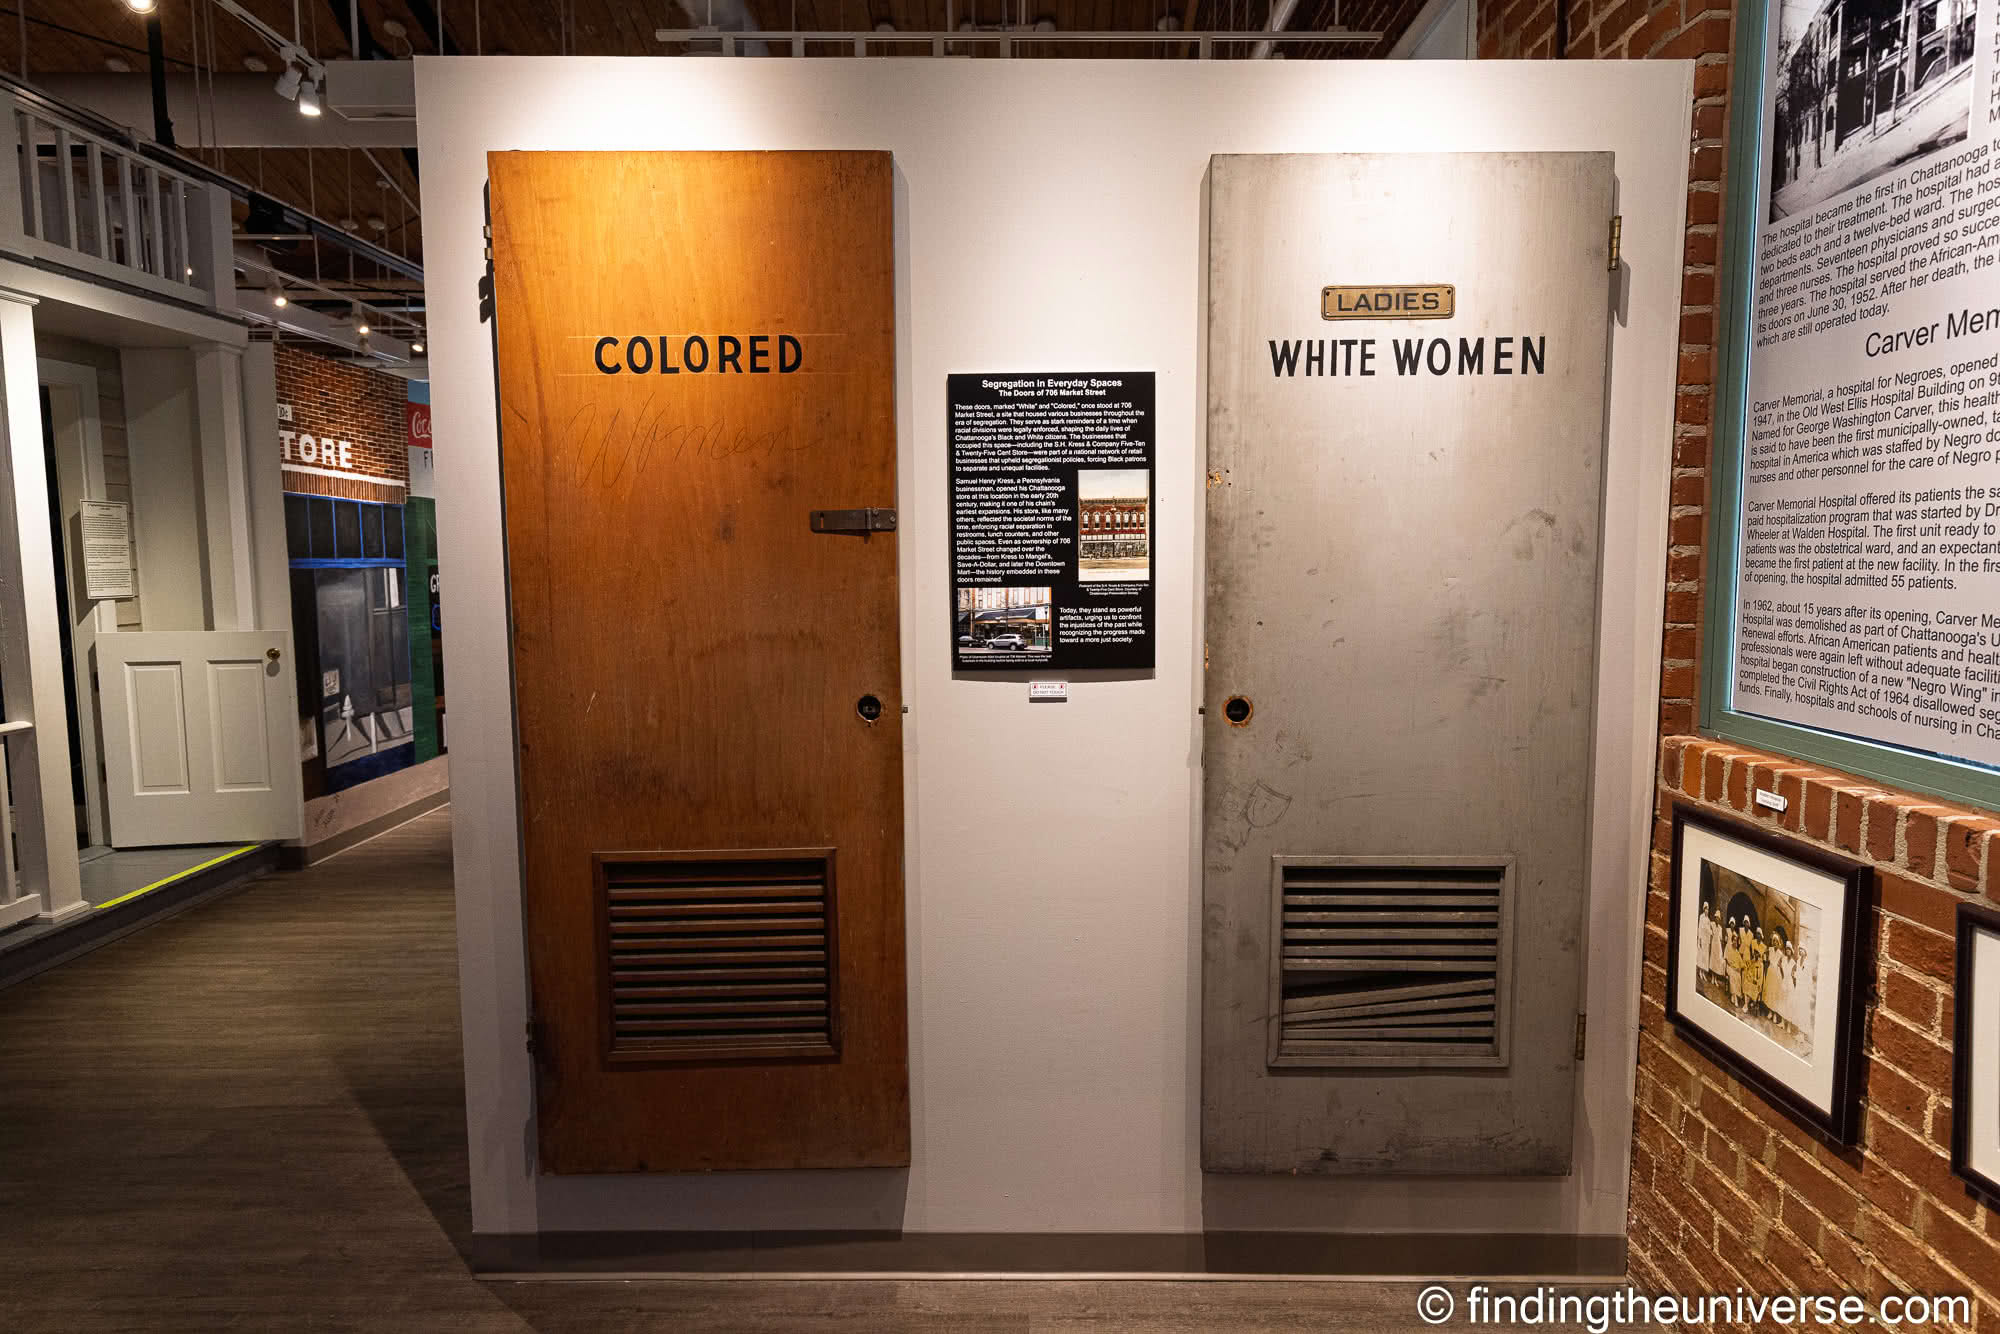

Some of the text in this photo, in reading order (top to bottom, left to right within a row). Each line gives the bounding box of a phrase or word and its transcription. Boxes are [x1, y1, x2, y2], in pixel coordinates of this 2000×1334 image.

[1760, 234, 1802, 261] dedicated
[1803, 232, 1812, 245] to
[1814, 222, 1836, 240] their
[1837, 201, 1888, 231] treatment.
[1891, 193, 1913, 210] The
[1915, 169, 1962, 200] hospital
[1965, 158, 1990, 181] had
[1761, 232, 1778, 248] The
[1779, 214, 1813, 239] hospital
[1815, 201, 1853, 224] became
[1855, 193, 1872, 208] the
[1874, 180, 1894, 200] first
[1897, 177, 1907, 191] in
[1910, 144, 1988, 185] Chattanooga
[1337, 292, 1439, 312] LADIES
[1757, 254, 1994, 334] its doors on June 30, 1952. After her death, the
[1756, 302, 1890, 349] which are still operated today.
[1865, 322, 1940, 357] Carver
[593, 335, 803, 374] COLORED
[1268, 336, 1546, 377] WHITE WOMEN
[981, 379, 1035, 389] Segregation
[1047, 378, 1088, 389] Everyday
[1089, 378, 1122, 388] Spaces
[1036, 388, 1044, 396] of
[1045, 388, 1058, 396] 706
[1752, 351, 2000, 413] Carver Memorial, a hospital for Negroes, opened
[1751, 425, 1781, 441] Named
[1782, 424, 1795, 437] for
[1796, 420, 1830, 435] George
[1832, 410, 1891, 429] Washington
[1893, 403, 1934, 420] Carver,
[1938, 397, 1960, 413] this
[1747, 500, 1775, 512] Carver
[1776, 496, 1816, 511] Memorial
[1818, 493, 1857, 510] Hospital
[1859, 490, 1896, 506] offered
[1898, 490, 1911, 503] its
[1914, 487, 1961, 506] patients
[1965, 485, 1985, 500] the
[1746, 521, 1996, 541] Wheeler at Walden Hospital. The first unit ready to
[1744, 570, 1957, 591] of opening, the hospital admitted 55 patients.
[1743, 598, 1751, 610] In
[1752, 599, 1774, 613] 1962,
[1776, 600, 1801, 613] about
[1803, 602, 1814, 615] 15
[1815, 606, 1842, 618] years
[1844, 605, 1868, 618] after
[1869, 606, 1881, 620] its
[1884, 608, 1932, 627] opening,
[1935, 610, 1978, 627] Carver
